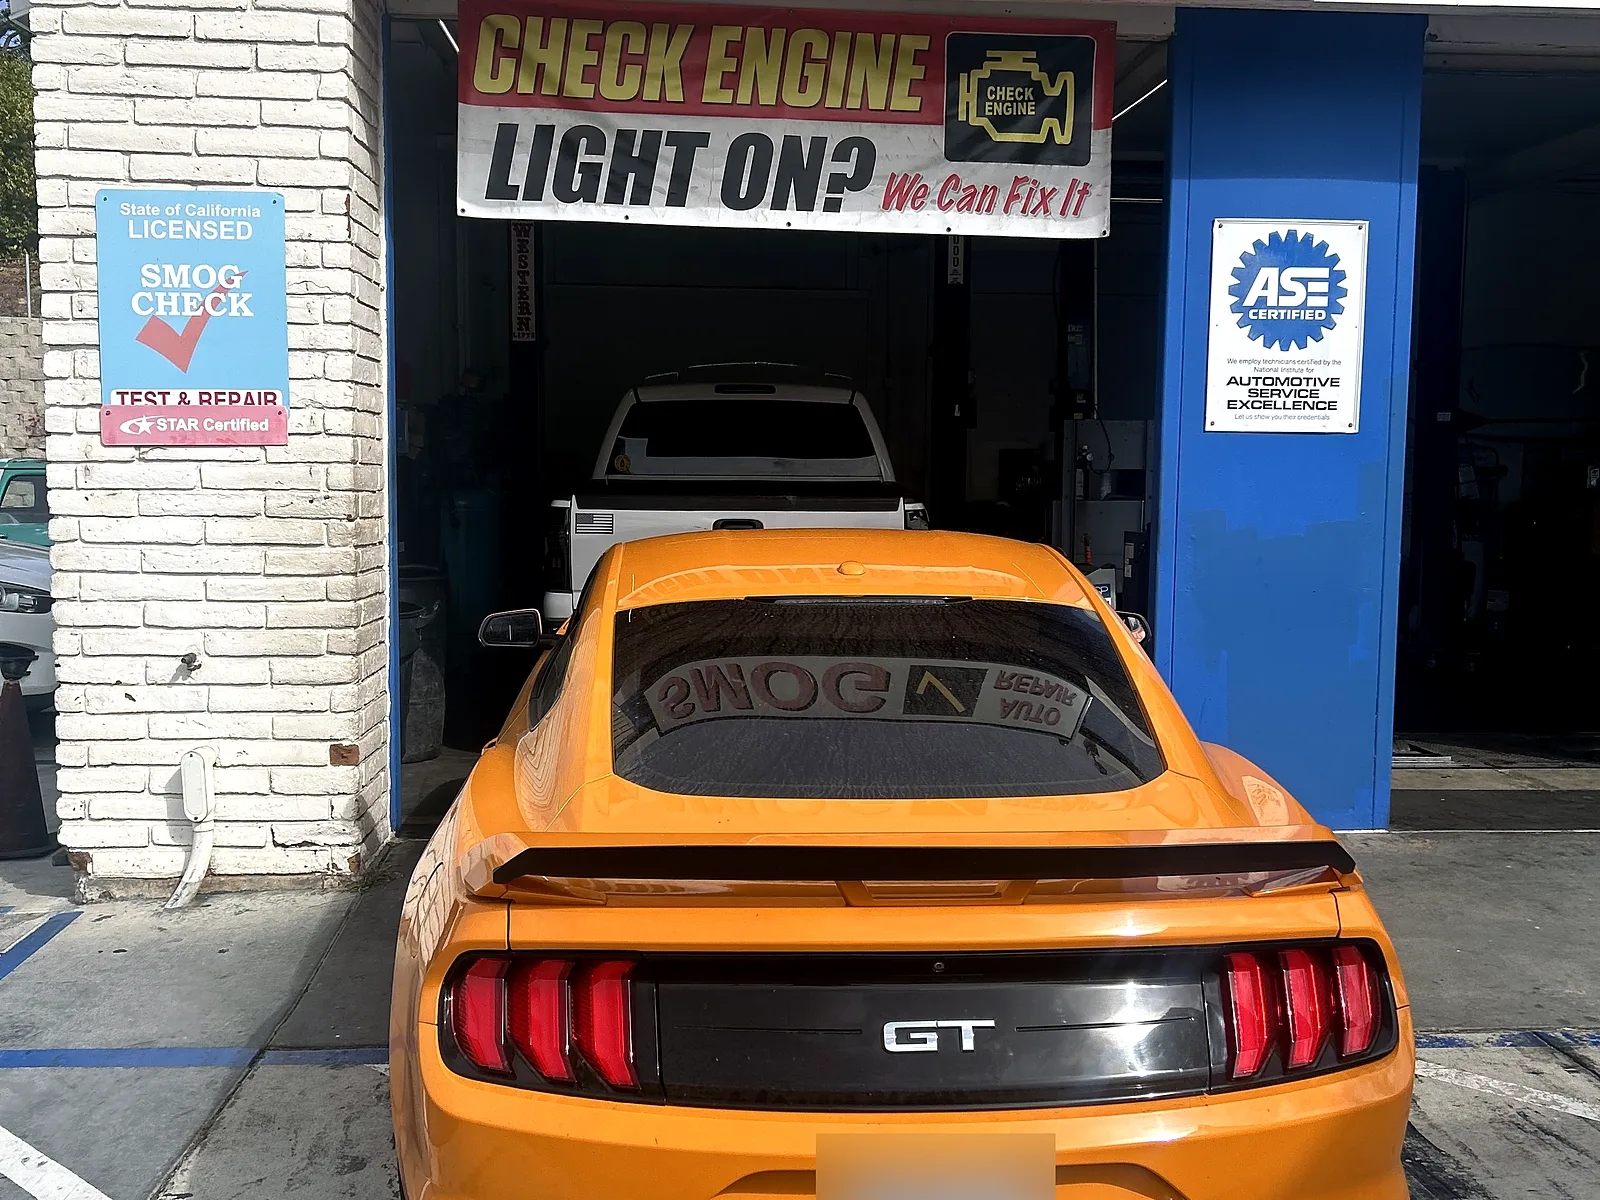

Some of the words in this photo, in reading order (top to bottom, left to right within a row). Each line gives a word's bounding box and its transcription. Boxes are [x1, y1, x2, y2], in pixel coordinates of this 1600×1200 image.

[473, 14, 695, 102] CHECK
[701, 25, 931, 112] ENGINE
[986, 85, 1034, 100] CHECK
[984, 101, 1036, 115] ENGINE
[484, 122, 711, 208] LIGHT
[720, 131, 877, 213] ON?
[881, 171, 930, 213] We
[936, 173, 1001, 214] Can
[1002, 175, 1058, 216] Fix
[1059, 178, 1092, 217] It
[120, 202, 160, 216] State
[165, 203, 181, 217] of
[185, 203, 261, 218] California
[128, 219, 253, 240] LICENSED
[140, 263, 243, 289] SMOG
[512, 222, 534, 332] WESTERN
[1242, 267, 1330, 307] ASE
[131, 292, 255, 317] CHECK
[1248, 309, 1327, 320] CERTIFIED
[1226, 376, 1341, 387] AUTOMOTIVE
[116, 391, 171, 406] TEST
[177, 391, 191, 406] &
[199, 391, 278, 406] REPAIR
[1248, 388, 1320, 399] SERVICE
[1227, 400, 1338, 411] EXCELLENCE
[156, 418, 200, 432] STAR
[203, 418, 269, 432] Certified
[883, 1020, 995, 1052] GT
